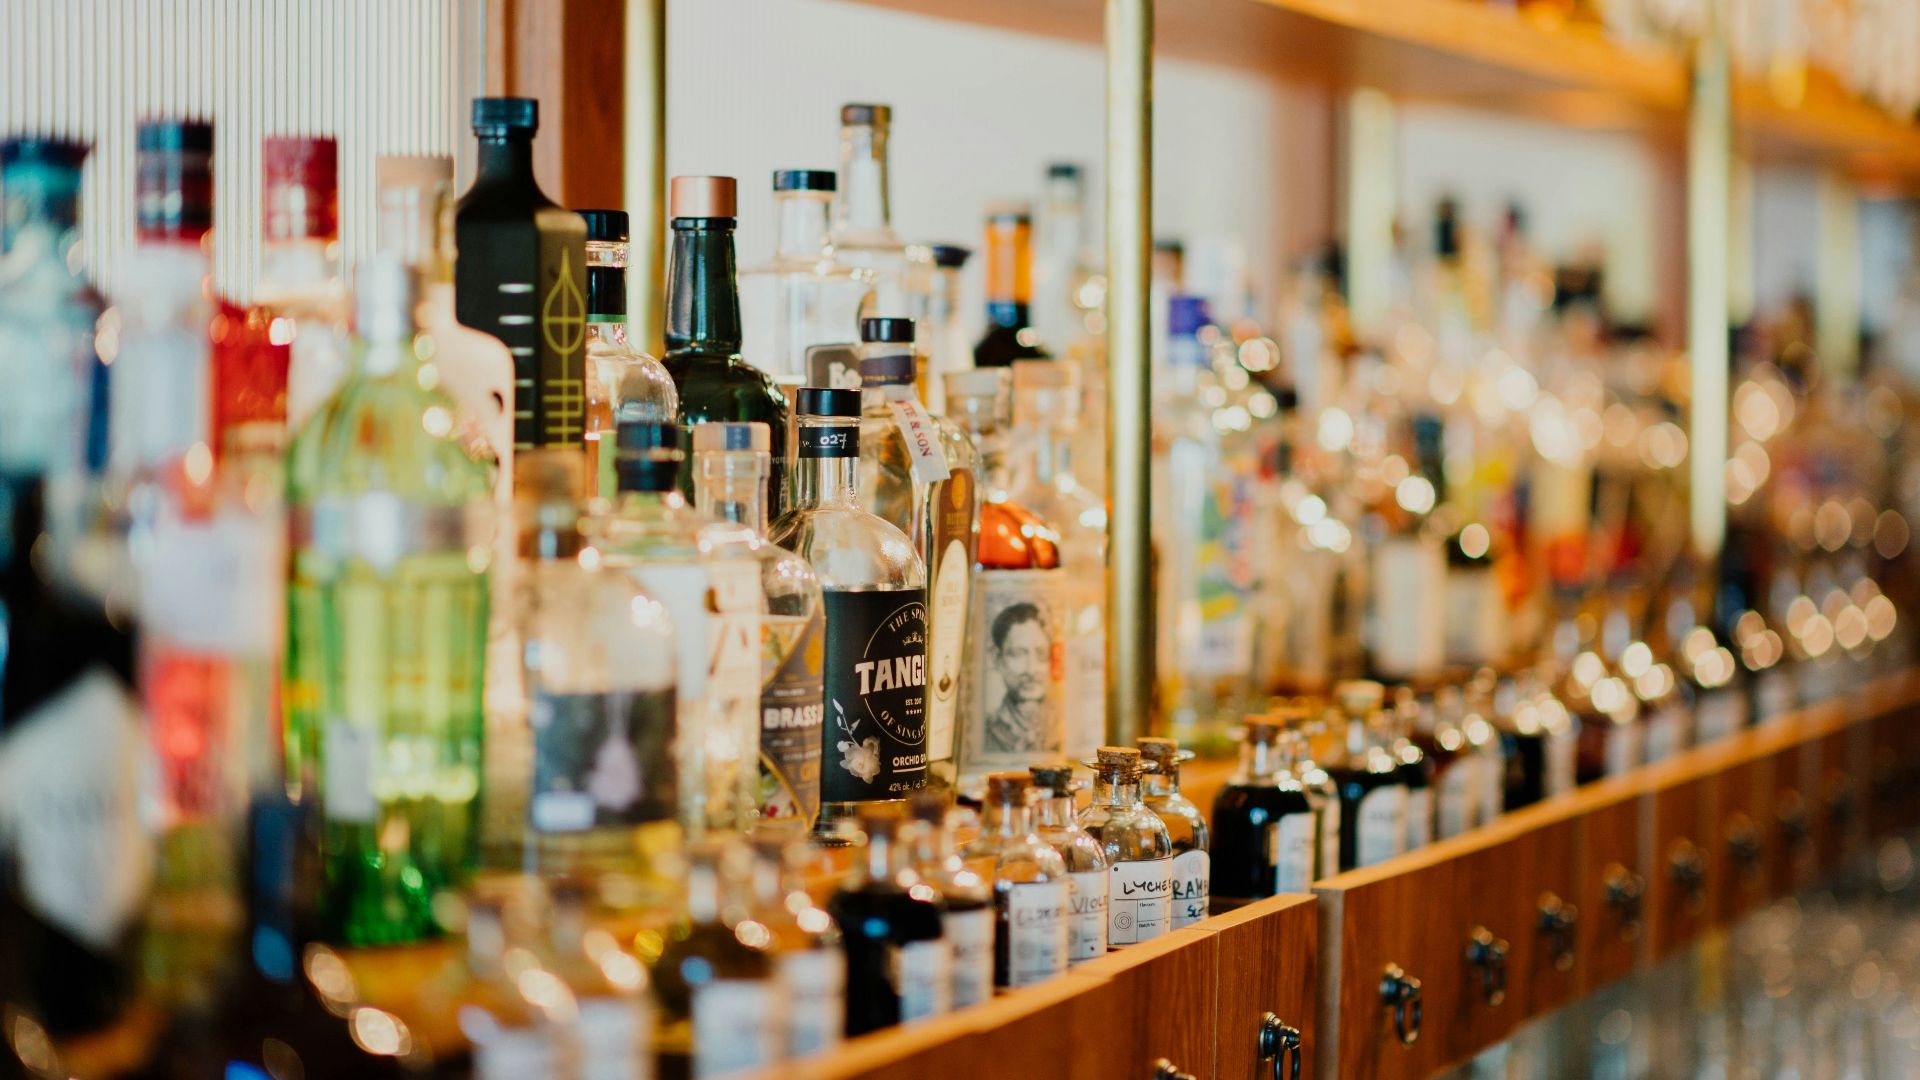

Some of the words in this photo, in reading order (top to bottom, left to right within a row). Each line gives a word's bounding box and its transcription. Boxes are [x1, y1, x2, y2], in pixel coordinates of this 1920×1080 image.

[819, 433, 847, 449] 027
[915, 432, 933, 457] SON
[888, 611, 908, 632] THE
[881, 710, 896, 726] OF
[892, 756, 920, 767] ORCHID
